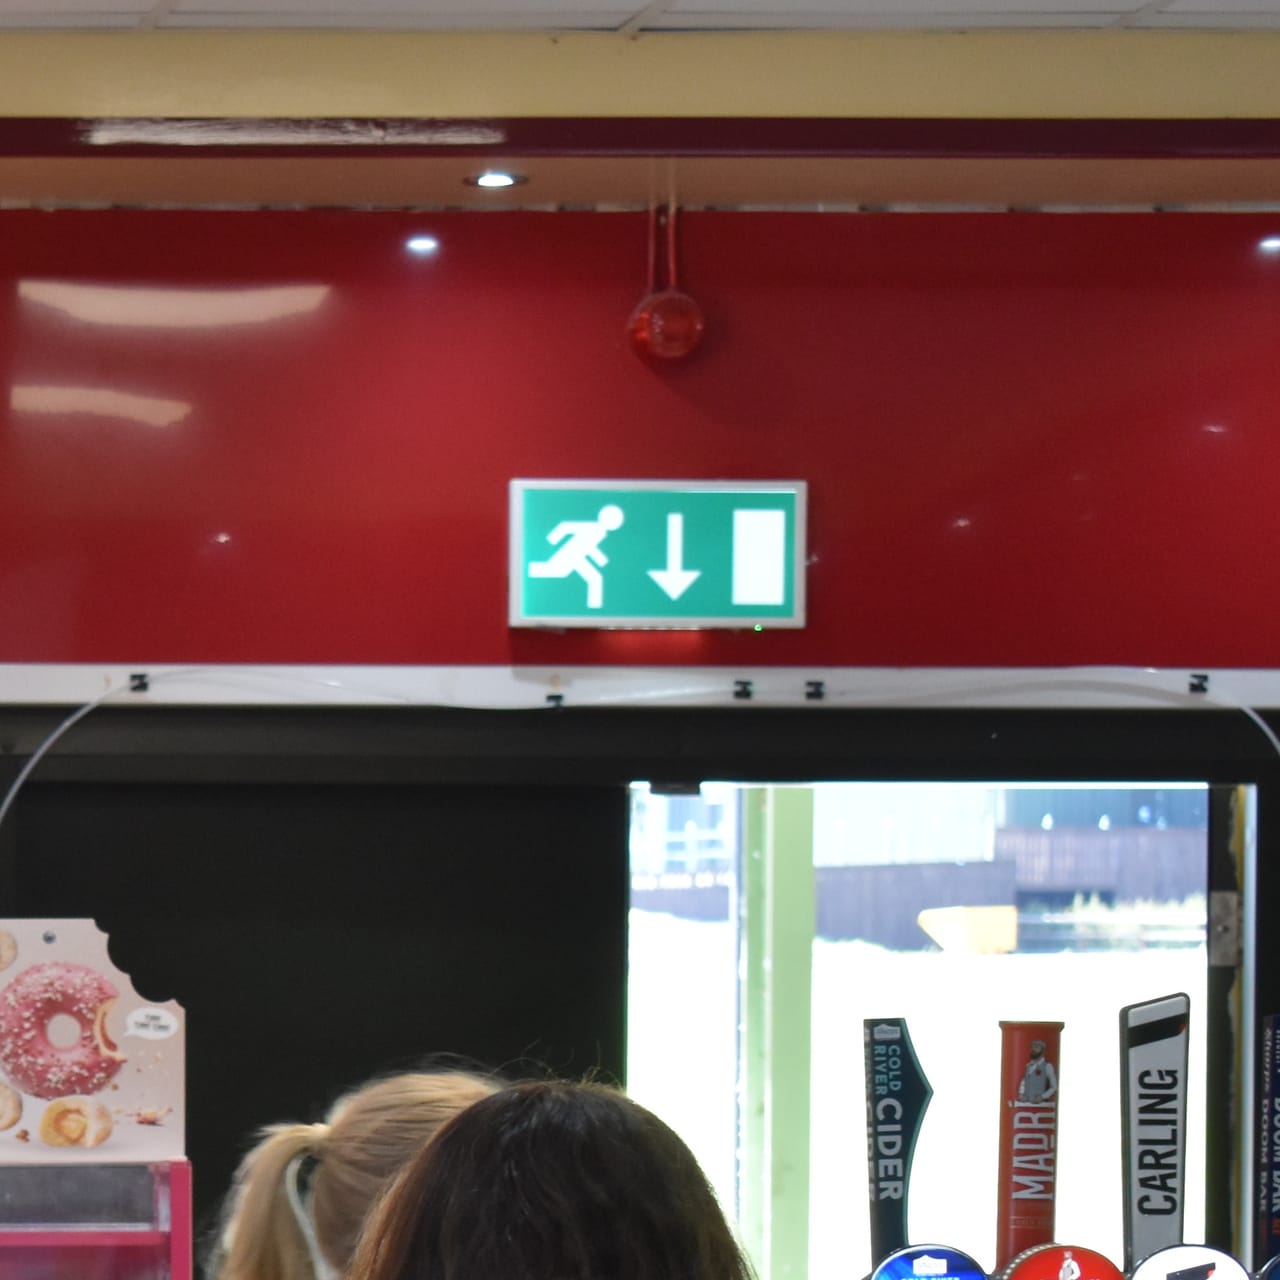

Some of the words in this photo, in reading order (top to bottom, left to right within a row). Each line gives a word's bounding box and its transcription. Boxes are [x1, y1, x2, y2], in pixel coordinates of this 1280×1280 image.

[874, 1045, 888, 1095] RIVER
[888, 1045, 902, 1092] COLD
[876, 1097, 904, 1201] CIDER
[1137, 1069, 1178, 1216] CARLING
